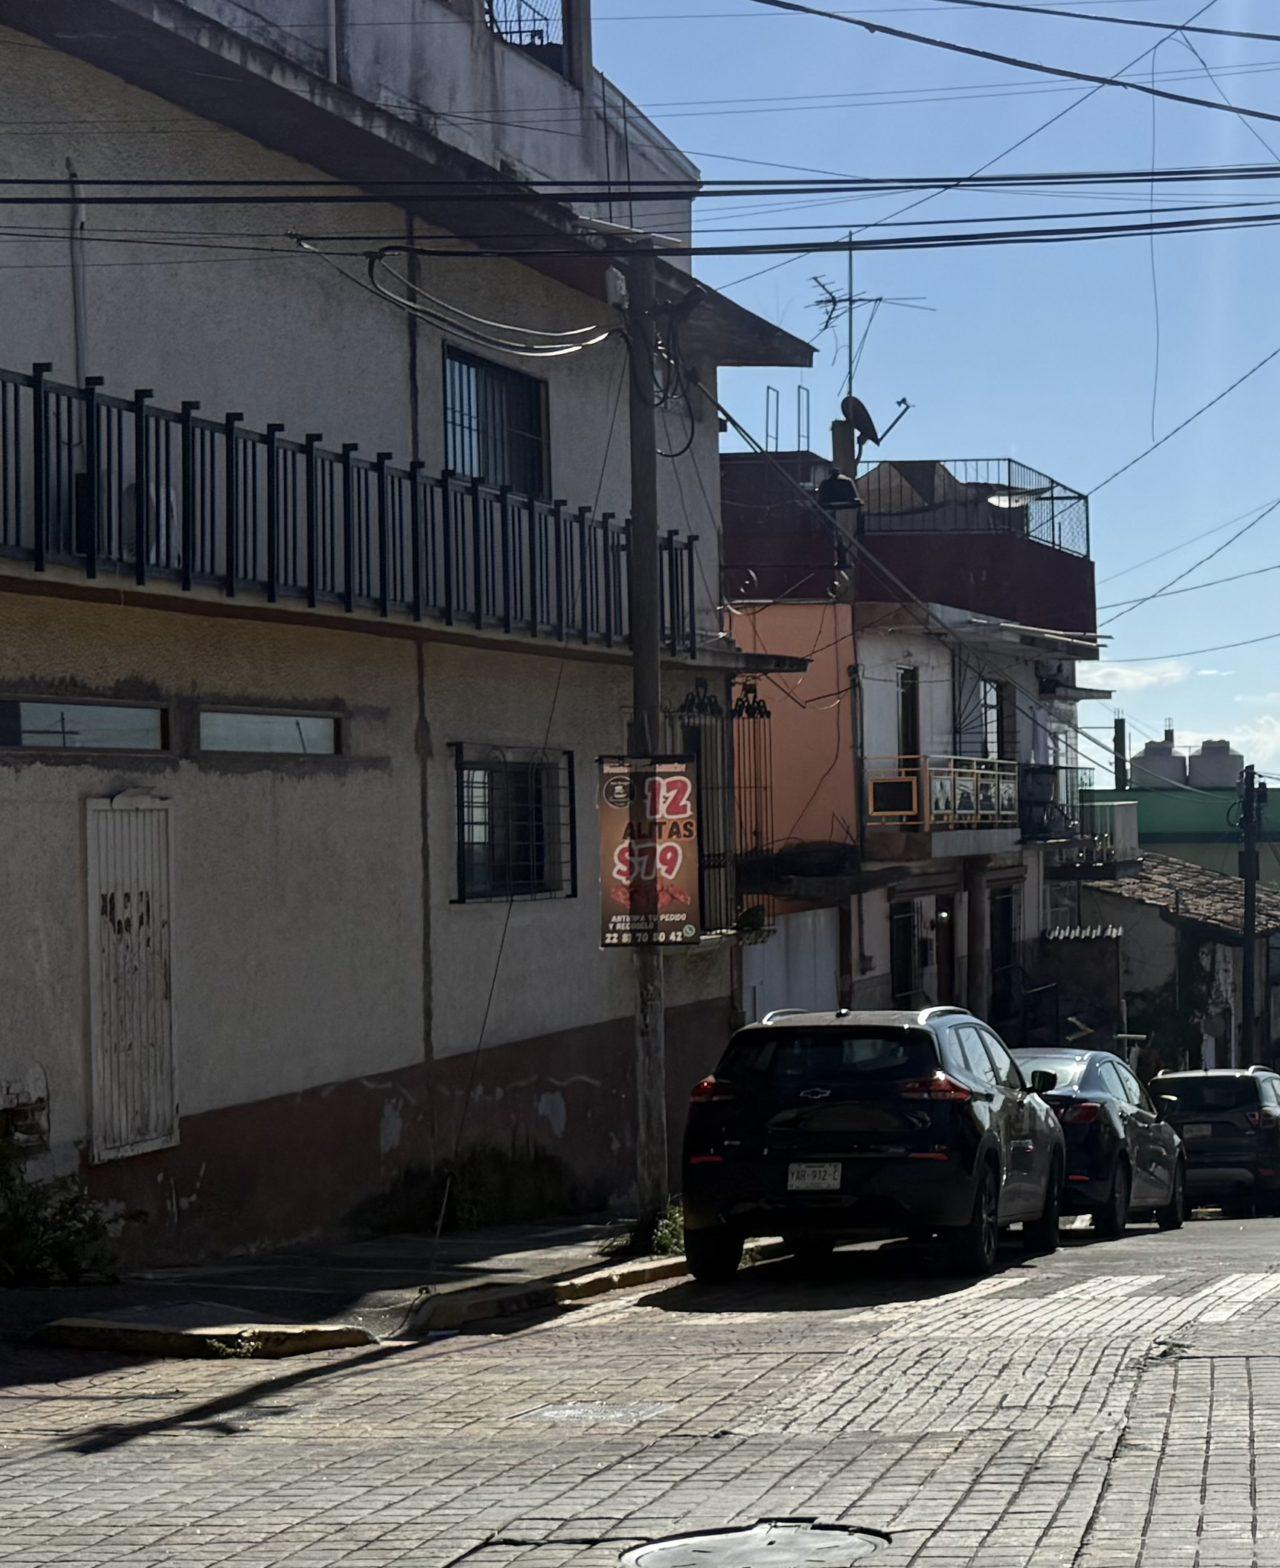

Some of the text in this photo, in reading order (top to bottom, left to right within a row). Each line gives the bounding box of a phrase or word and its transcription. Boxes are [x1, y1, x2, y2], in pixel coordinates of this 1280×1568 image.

[645, 776, 693, 819] 12
[623, 820, 695, 840] ALITAS
[612, 841, 682, 885] $79
[659, 912, 687, 922] PEDIDO
[608, 922, 615, 930] Y
[604, 932, 619, 944] 22
[669, 931, 683, 942] 42
